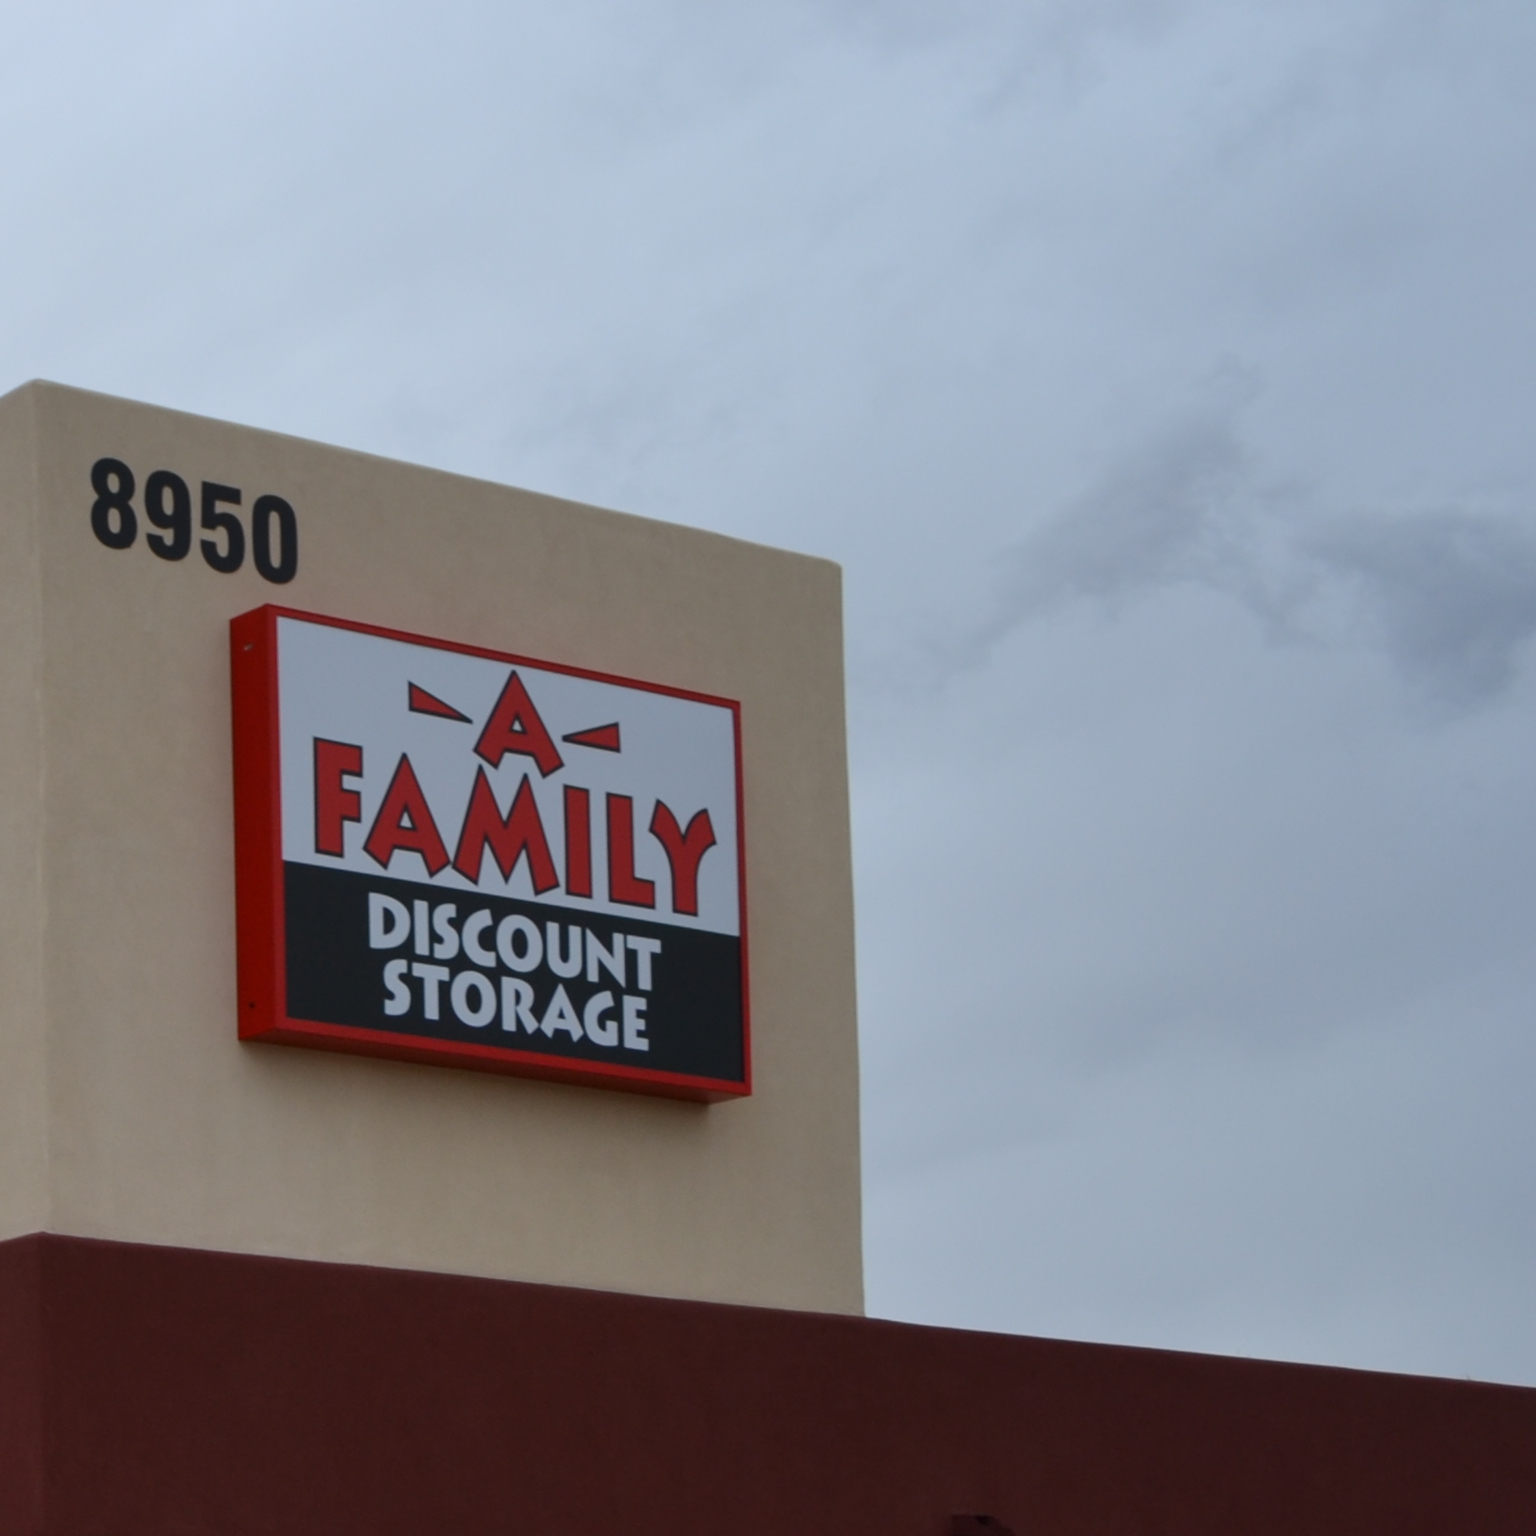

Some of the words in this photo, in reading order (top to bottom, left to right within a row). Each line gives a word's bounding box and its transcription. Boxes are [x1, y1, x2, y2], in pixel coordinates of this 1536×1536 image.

[90, 457, 299, 585] 8950
[472, 669, 565, 779] A
[312, 736, 717, 917] FAMILY
[368, 892, 662, 992] DISCOUNT
[383, 959, 650, 1052] STORAGE
